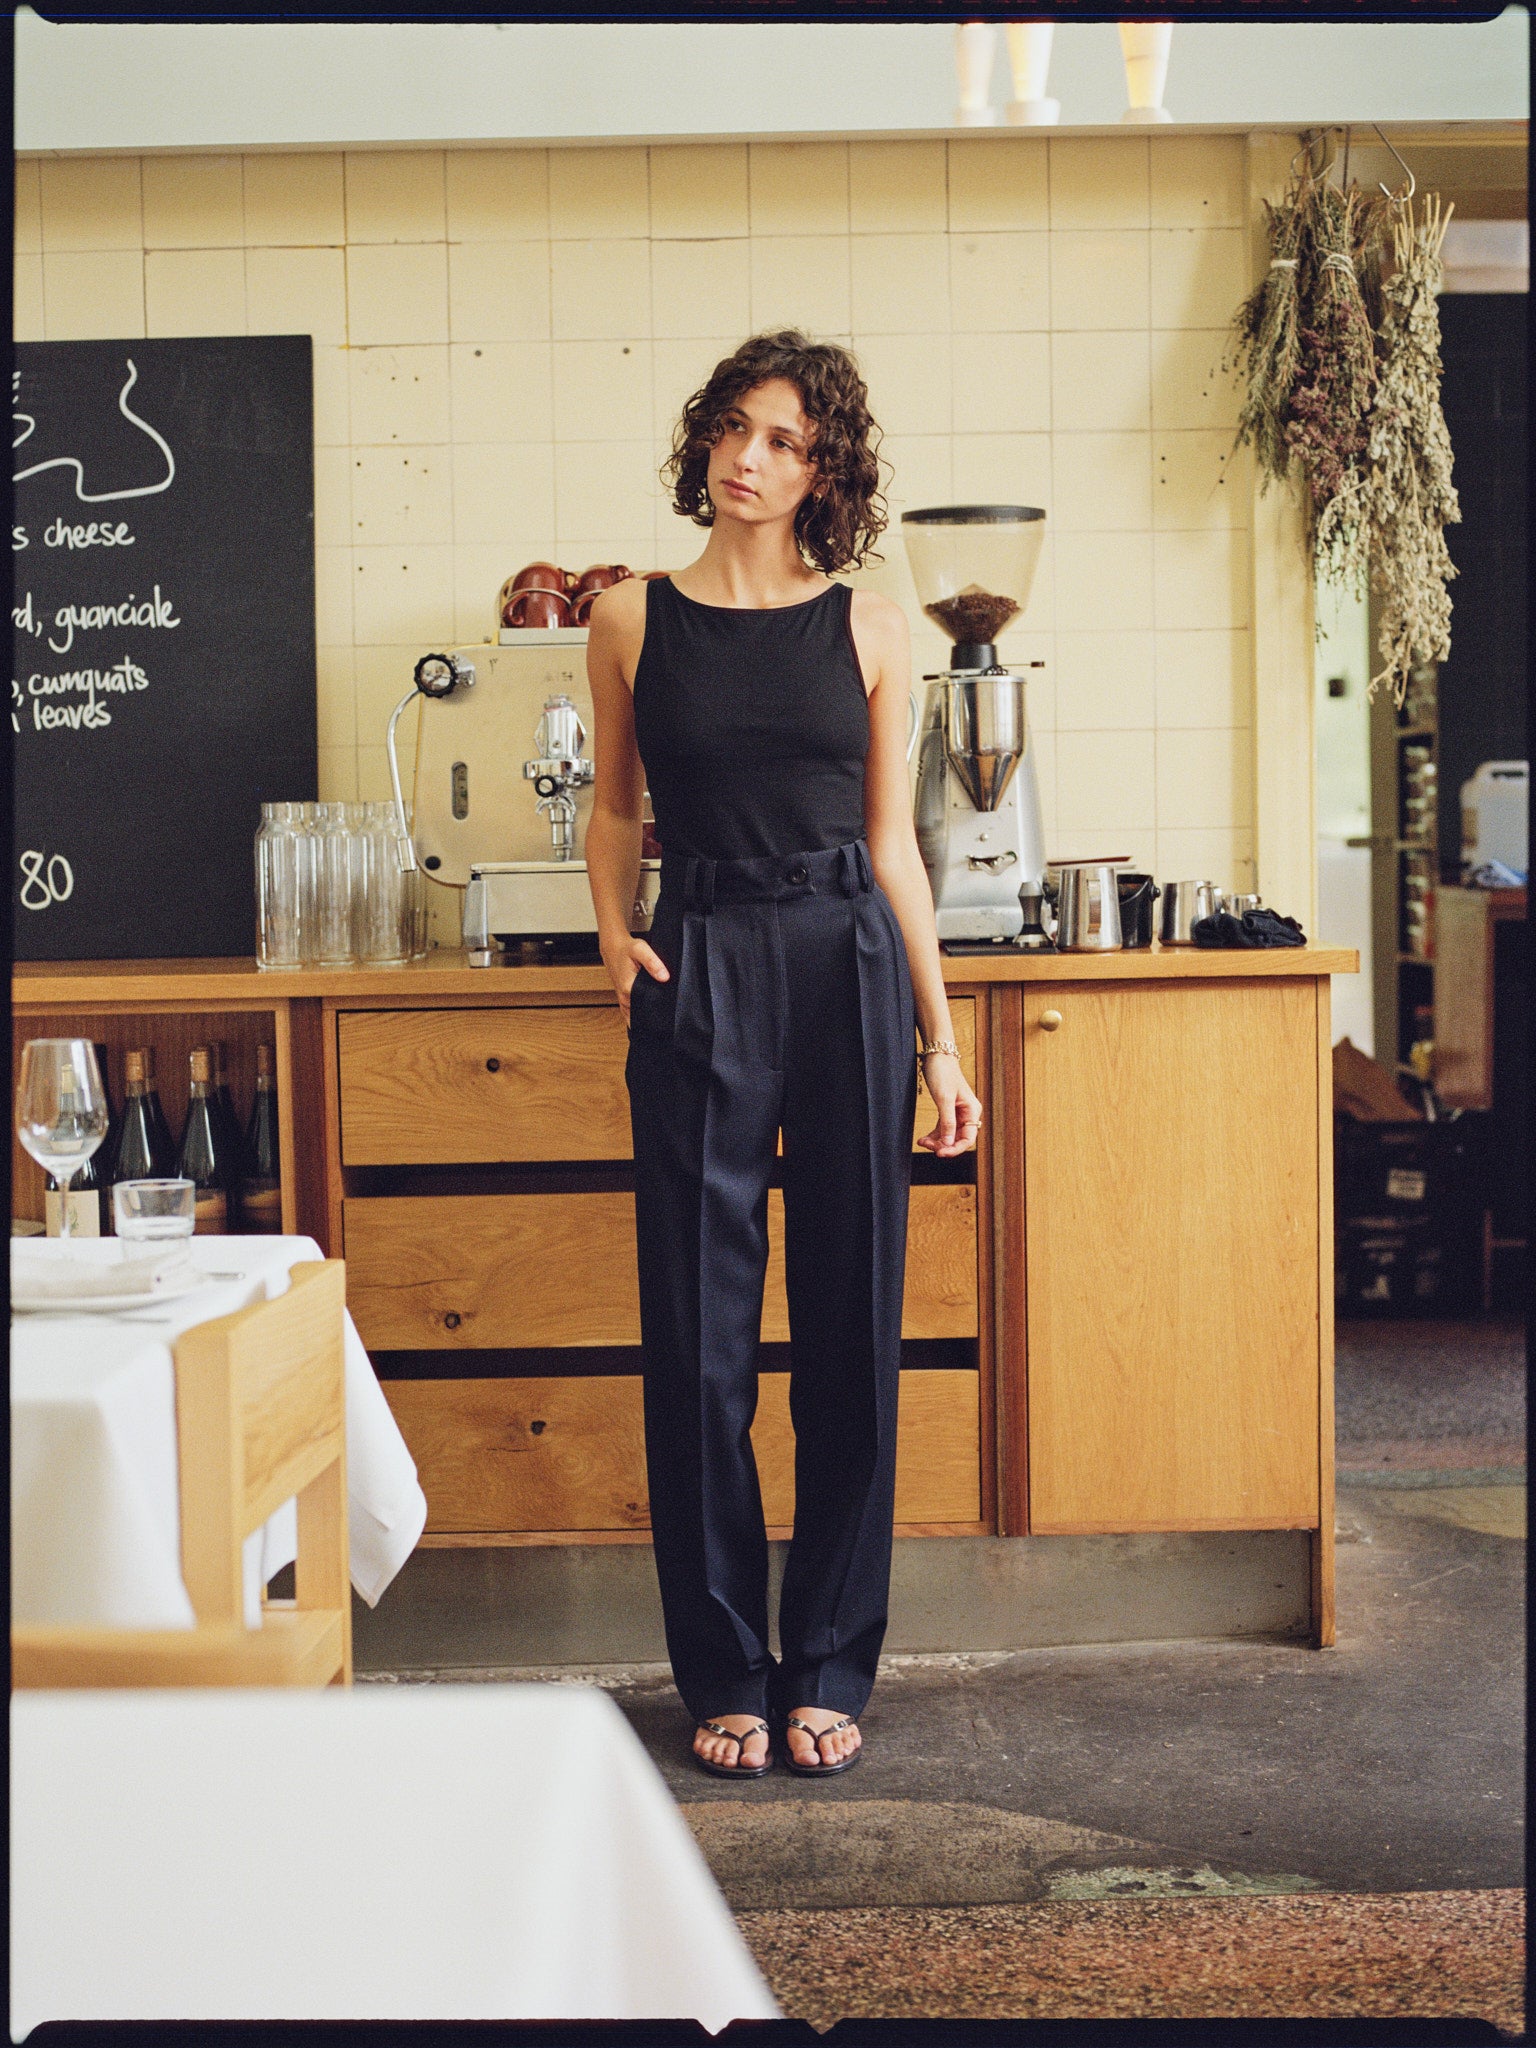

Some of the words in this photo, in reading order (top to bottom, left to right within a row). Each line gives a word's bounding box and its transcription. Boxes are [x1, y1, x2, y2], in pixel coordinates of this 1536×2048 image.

[44, 517, 136, 550] cheese
[48, 584, 181, 654] guanciale
[28, 655, 149, 707] cumquats
[33, 698, 112, 731] leaves
[20, 850, 74, 910] 80
